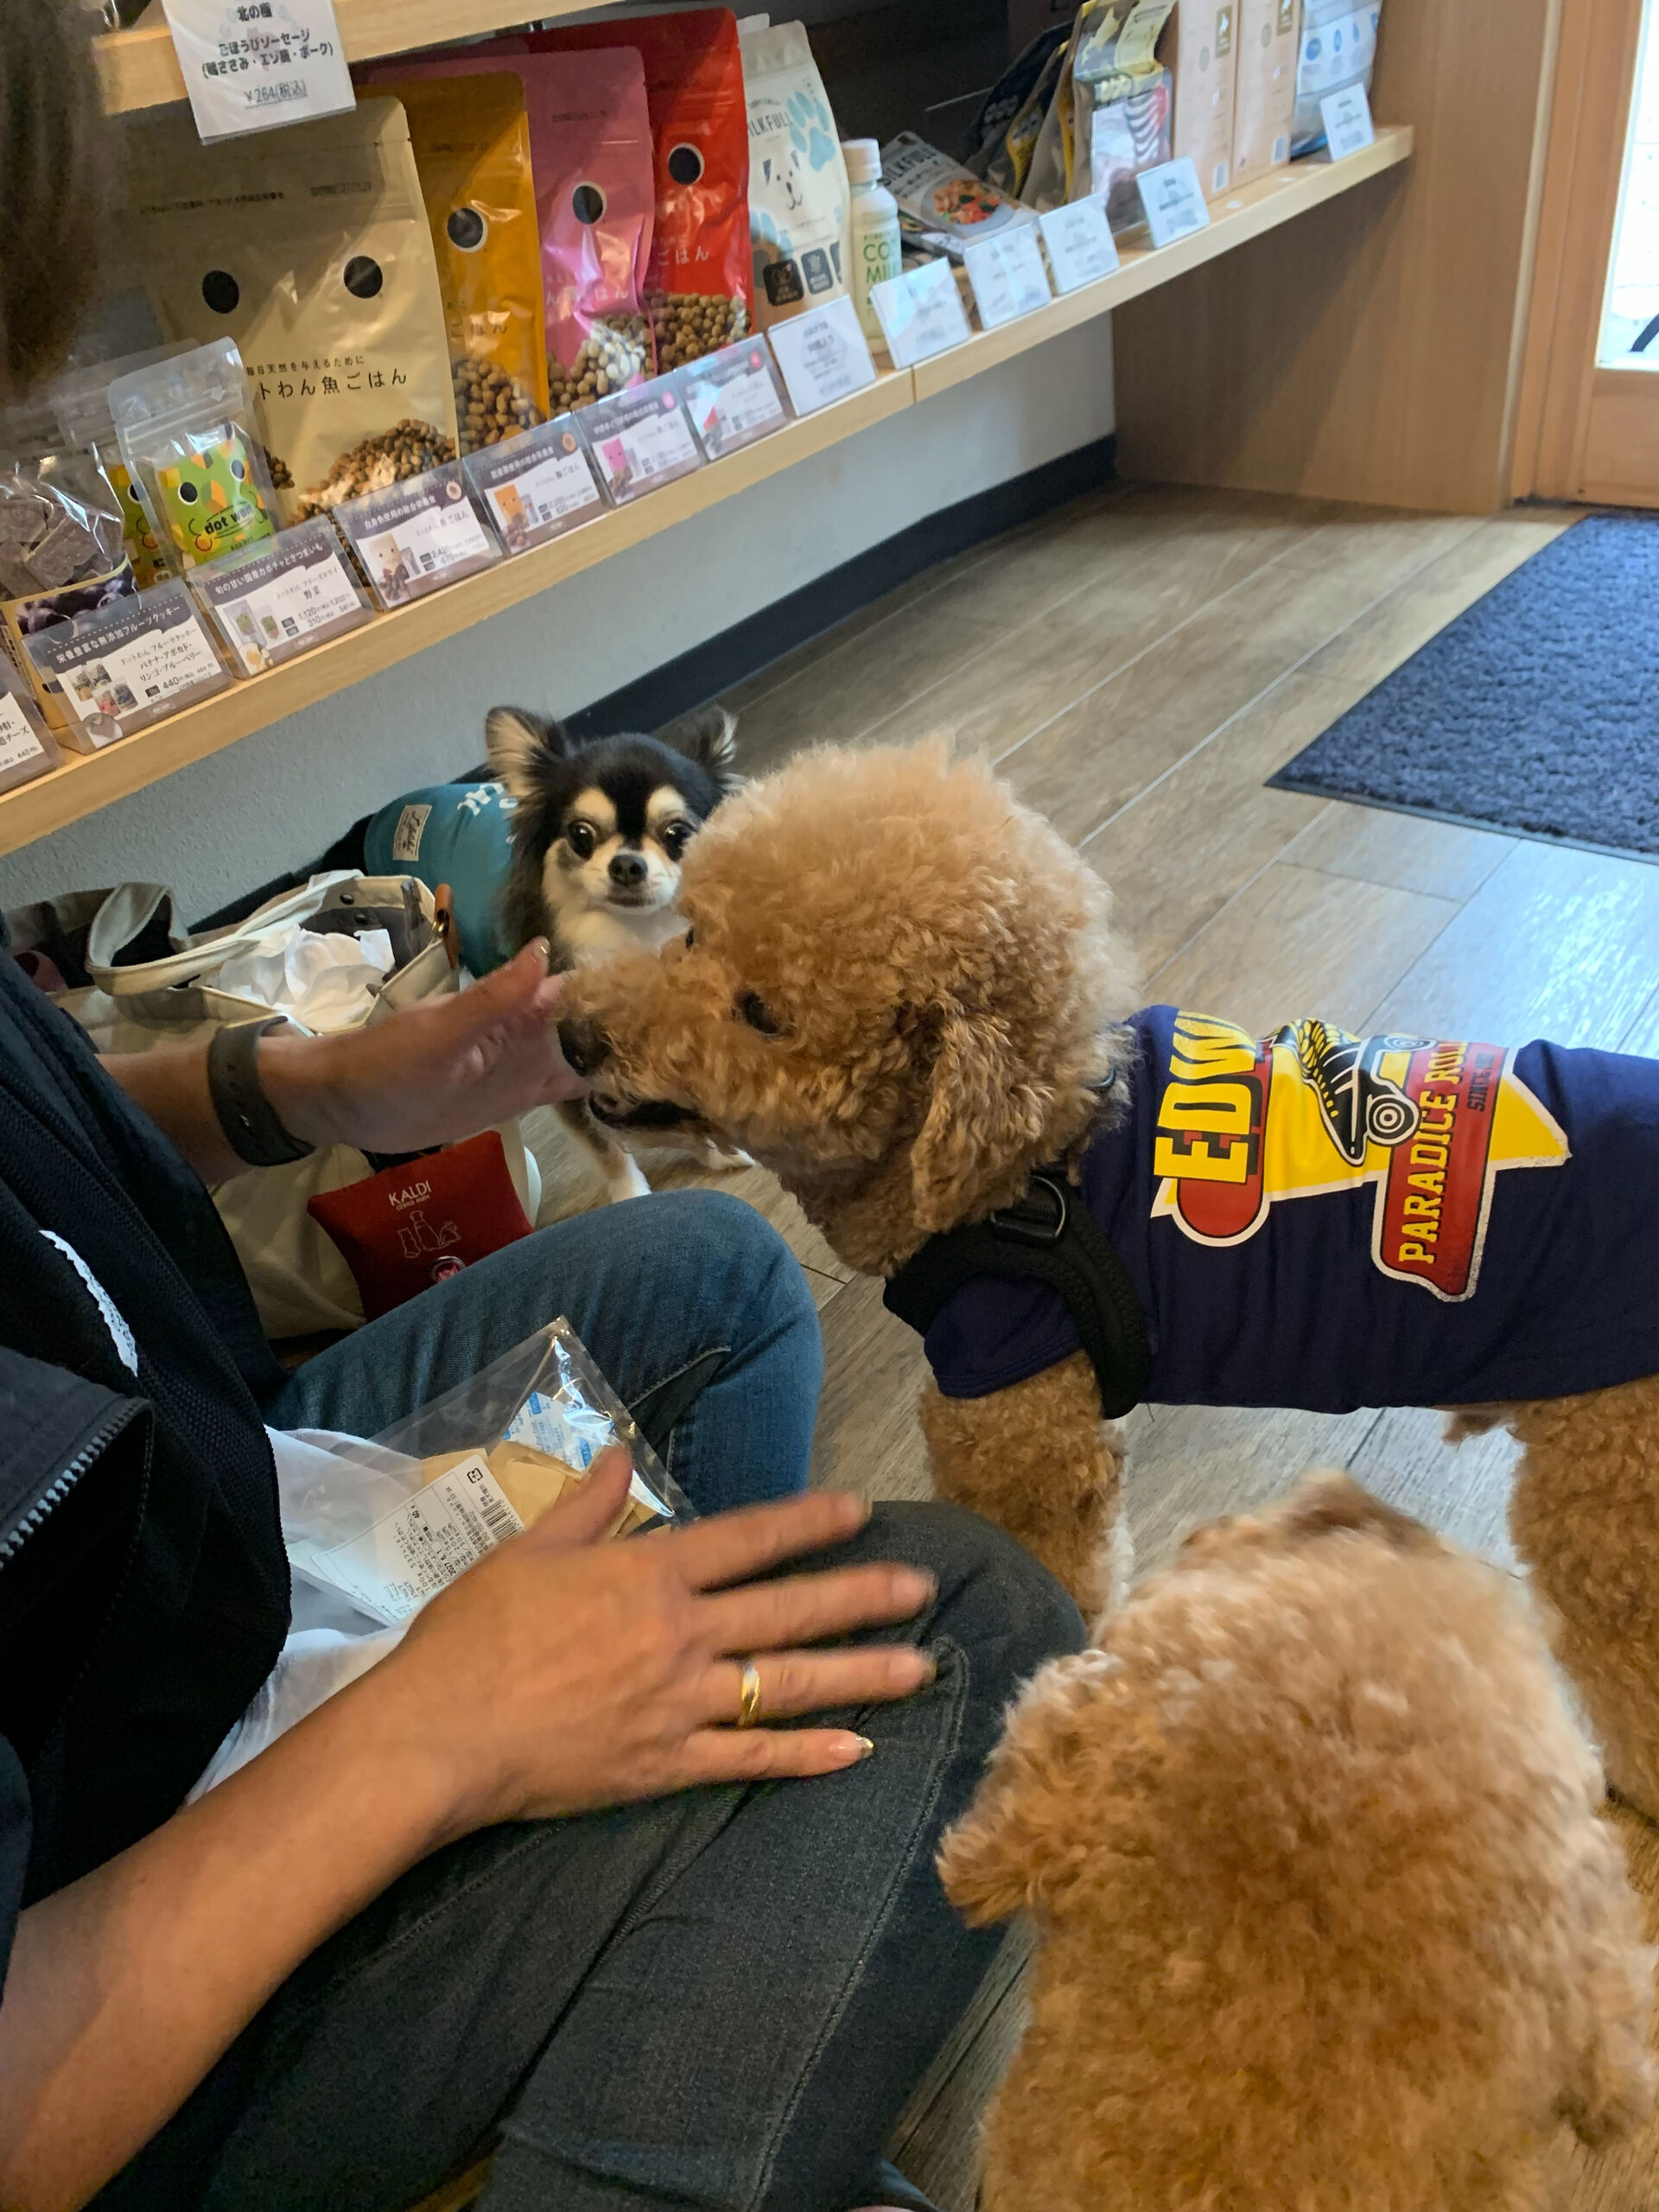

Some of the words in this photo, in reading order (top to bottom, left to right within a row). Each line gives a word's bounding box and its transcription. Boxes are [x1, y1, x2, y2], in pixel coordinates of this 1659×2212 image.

[219, 29, 310, 57] ごほうびソーセージ
[747, 111, 793, 137] ILKFULL
[205, 516, 228, 534] dot
[216, 543, 323, 595] 旬の甘い国産カボチャとさつまいも
[56, 605, 181, 664] 栄養豊富な無添加フルーツクッキー
[1154, 1010, 1257, 1184] EDW
[1398, 1090, 1459, 1265] PARADICE
[388, 1179, 432, 1206] KALDI
[411, 1510, 422, 1520] 40
